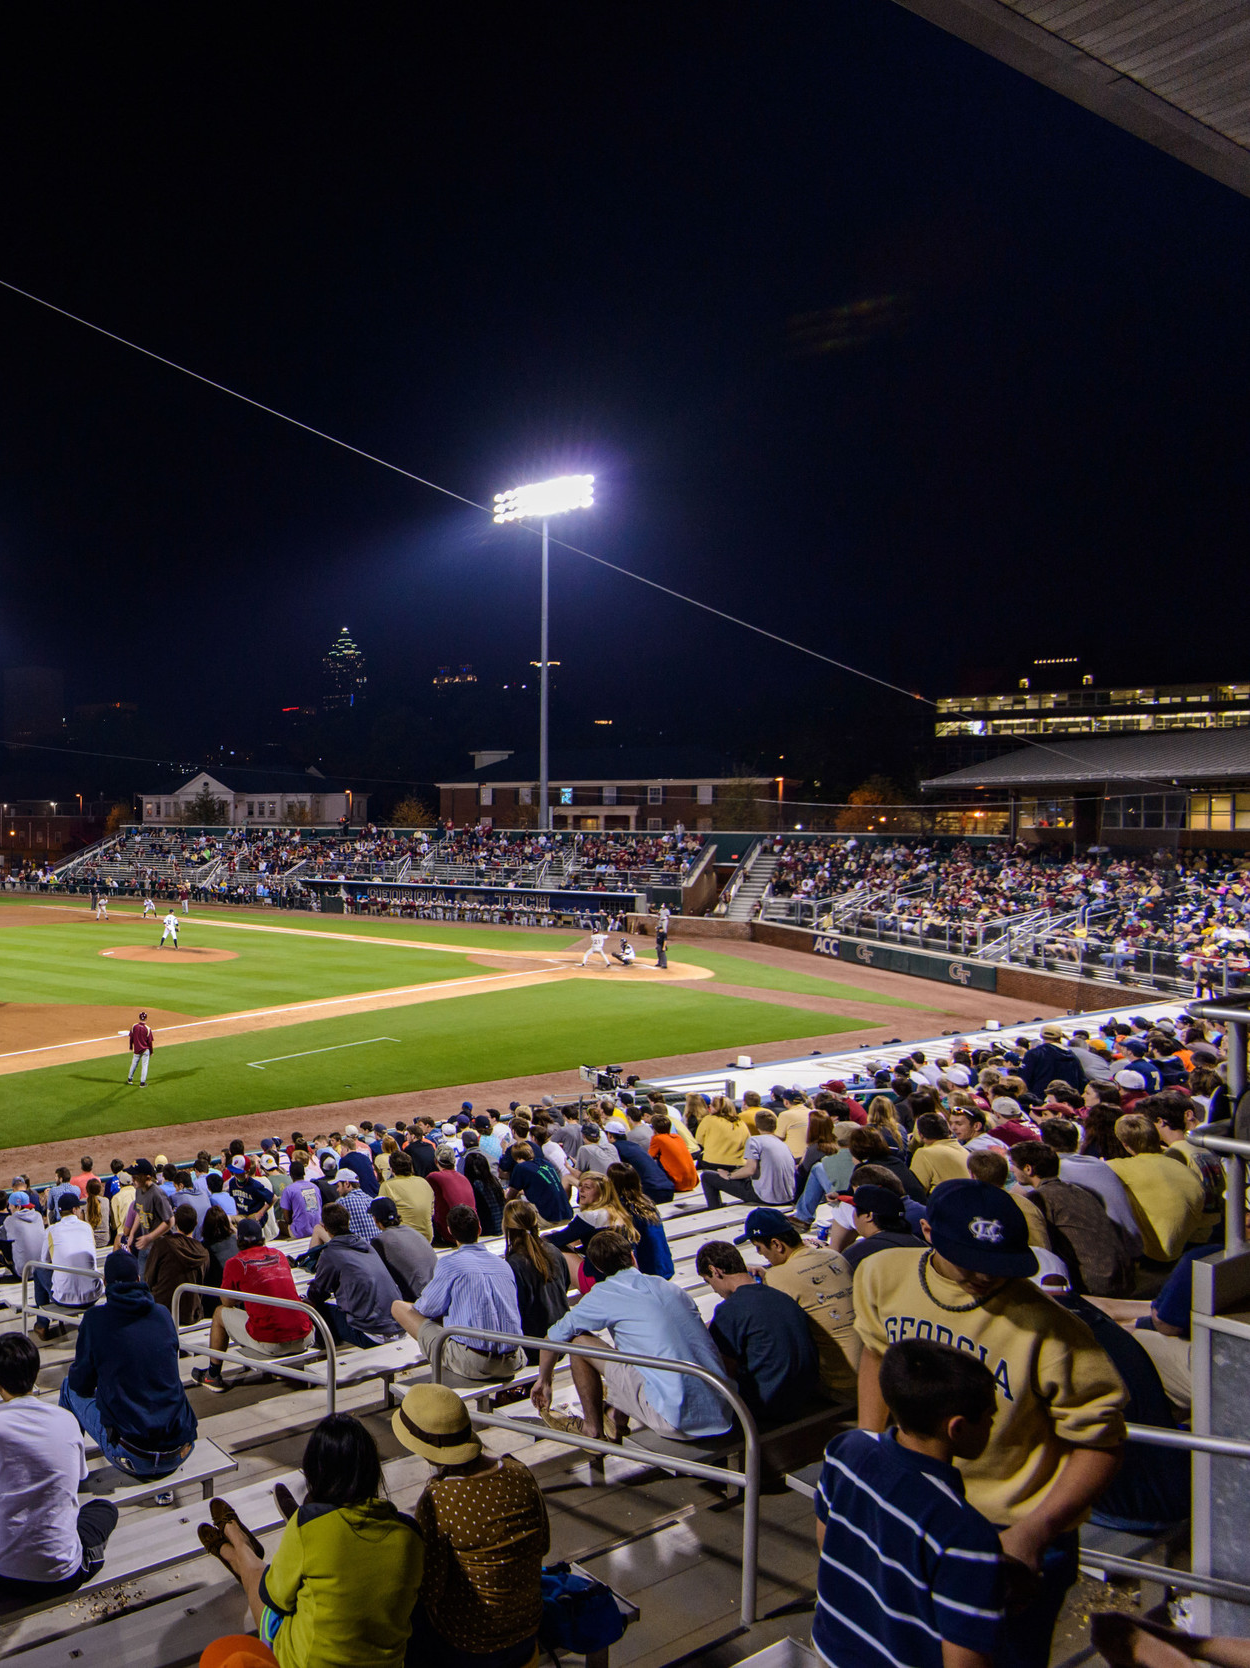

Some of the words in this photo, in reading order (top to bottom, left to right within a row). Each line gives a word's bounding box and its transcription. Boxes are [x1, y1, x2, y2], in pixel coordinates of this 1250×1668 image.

[367, 886, 447, 903] GEORGIA
[495, 892, 551, 910] TECH
[813, 937, 839, 955] ACC
[949, 962, 972, 984] GT
